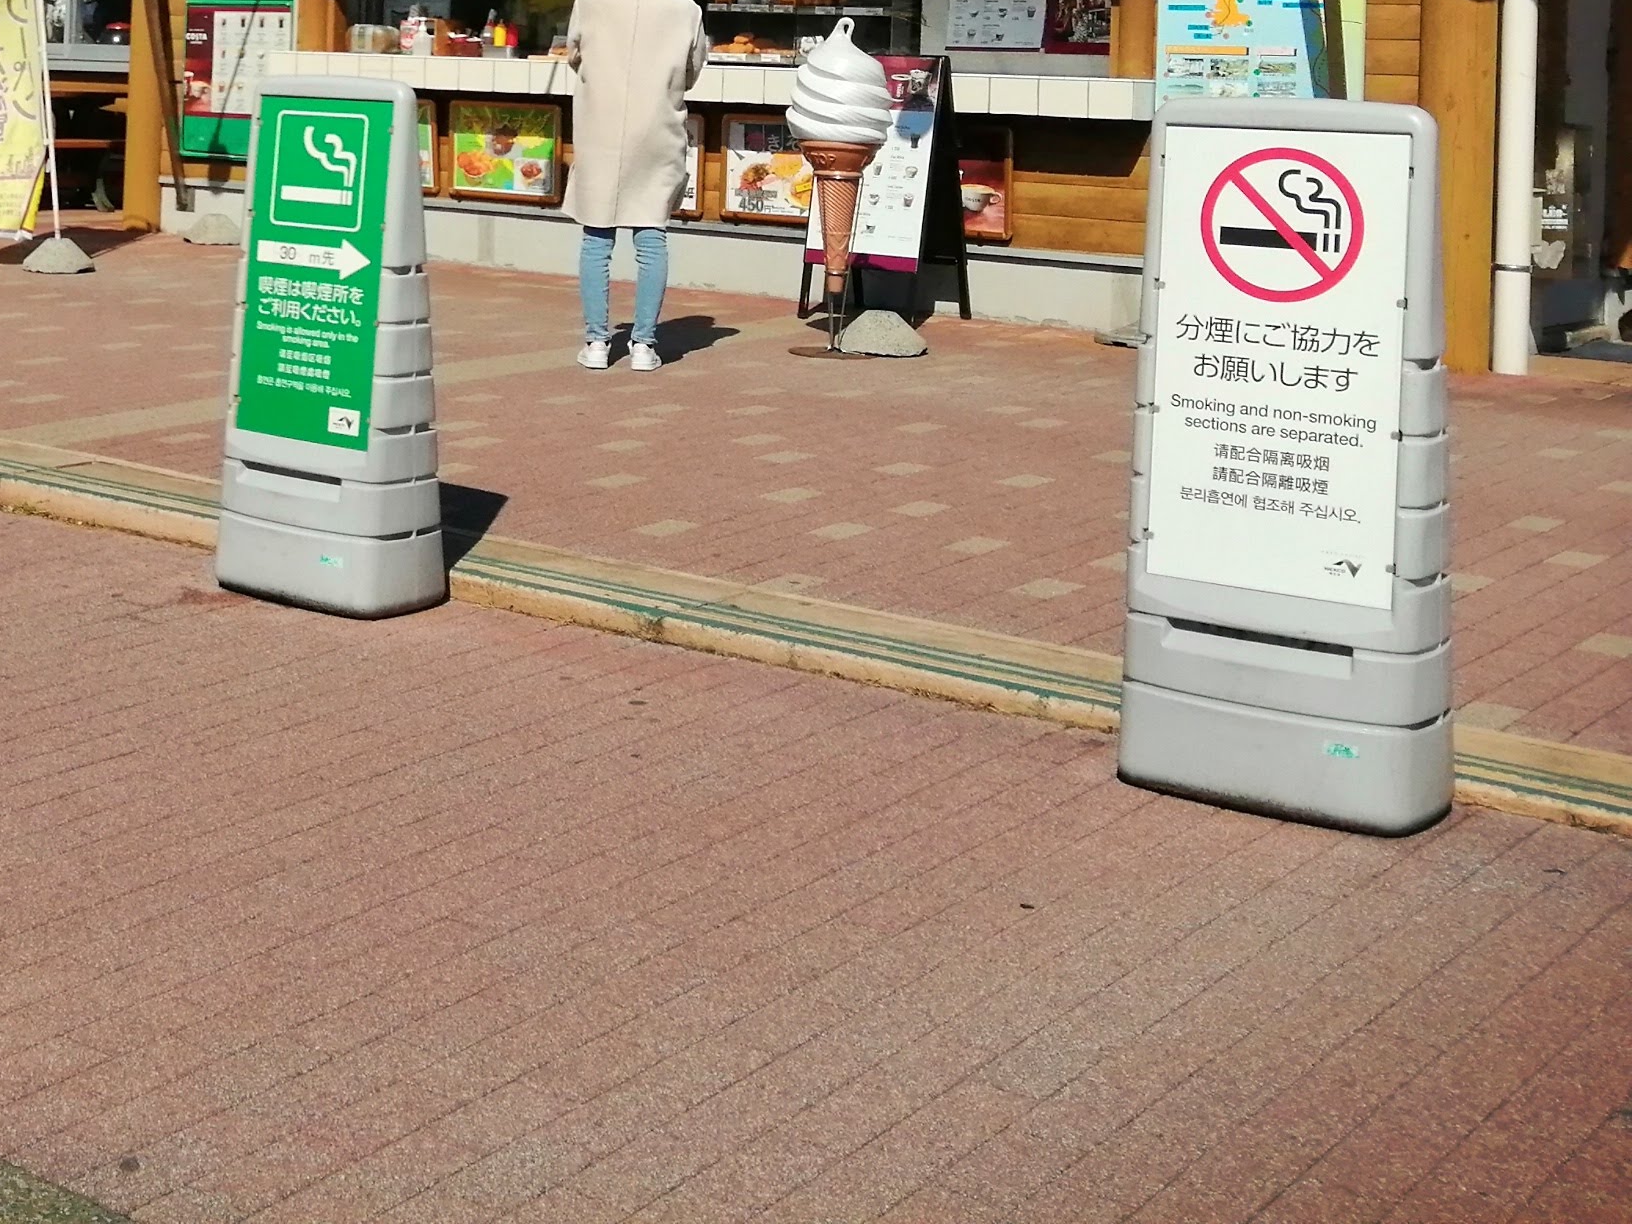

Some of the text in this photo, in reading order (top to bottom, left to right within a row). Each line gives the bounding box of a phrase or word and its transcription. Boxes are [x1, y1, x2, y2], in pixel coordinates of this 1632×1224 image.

[279, 245, 334, 266] 30 m先
[258, 276, 365, 306] 喫煙は喫煙所を
[258, 297, 361, 327] ご利用ください。
[1175, 313, 1382, 358] 分煙にご協力を
[1193, 353, 1359, 392] お願いします
[1170, 393, 1377, 433] Smoking and non-smoking
[1184, 415, 1364, 448] sections are separated.
[1213, 442, 1331, 472] 请配合隔离吸烟
[1212, 466, 1329, 496] 請配合隔離吸煙
[1179, 485, 1361, 524] 분리흡연에 협조해 주십시오.
